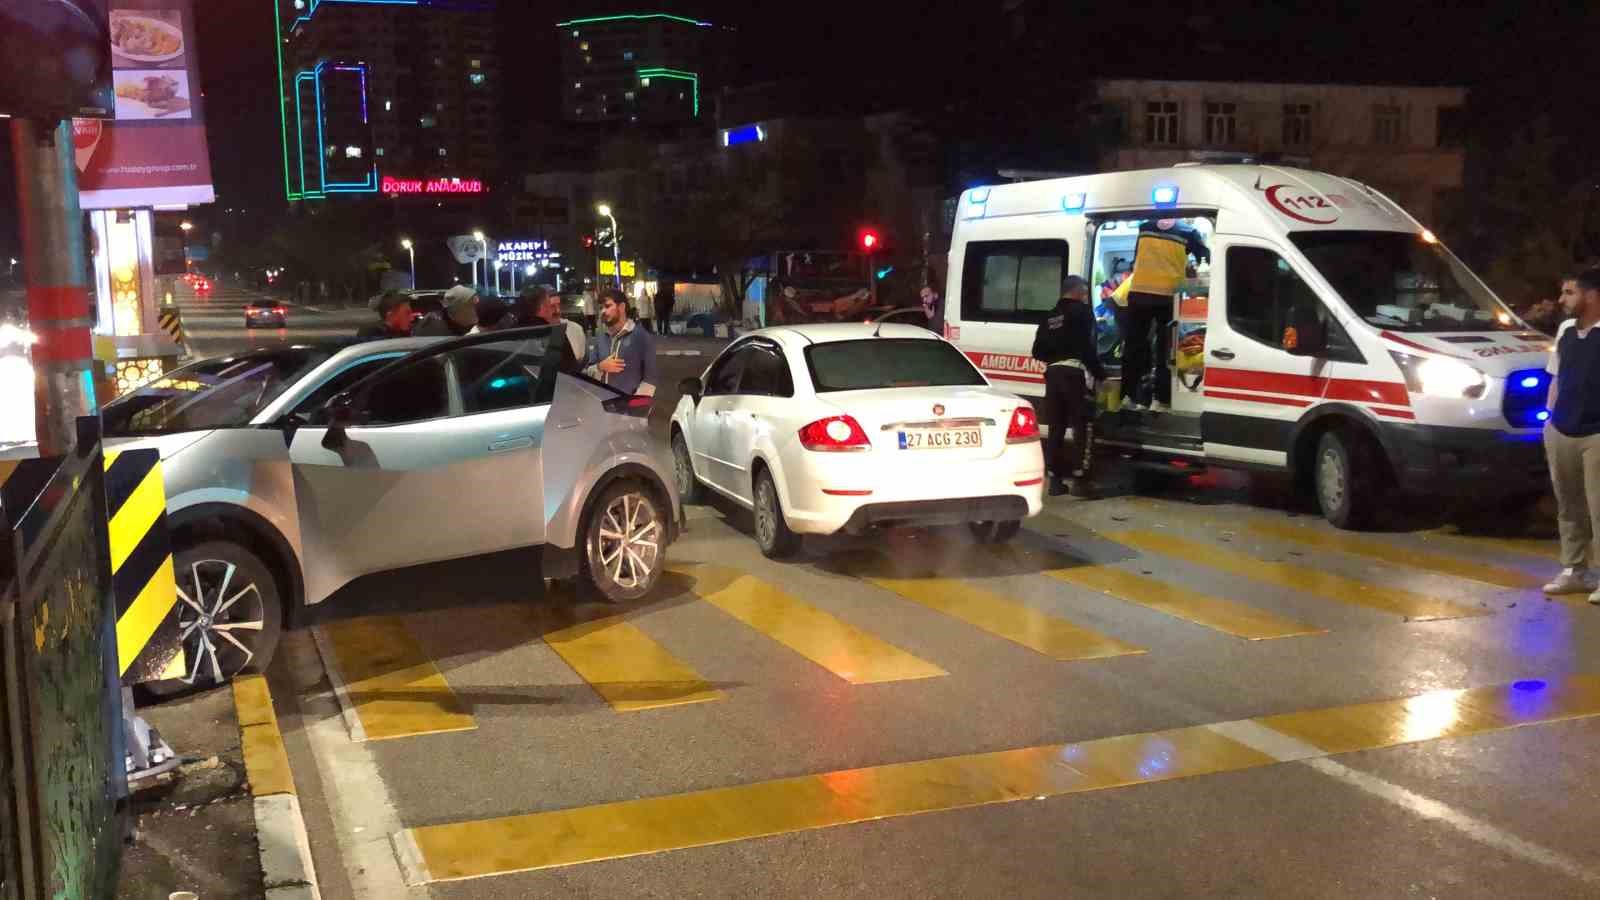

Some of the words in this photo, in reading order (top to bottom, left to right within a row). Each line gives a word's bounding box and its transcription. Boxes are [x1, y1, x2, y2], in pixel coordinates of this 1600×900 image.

[383, 181, 422, 192] DORUK
[1284, 196, 1332, 209] 112
[980, 354, 1047, 373] AMBULANS
[907, 433, 922, 447] 27
[927, 432, 950, 446] ACG
[955, 431, 978, 445] 230
